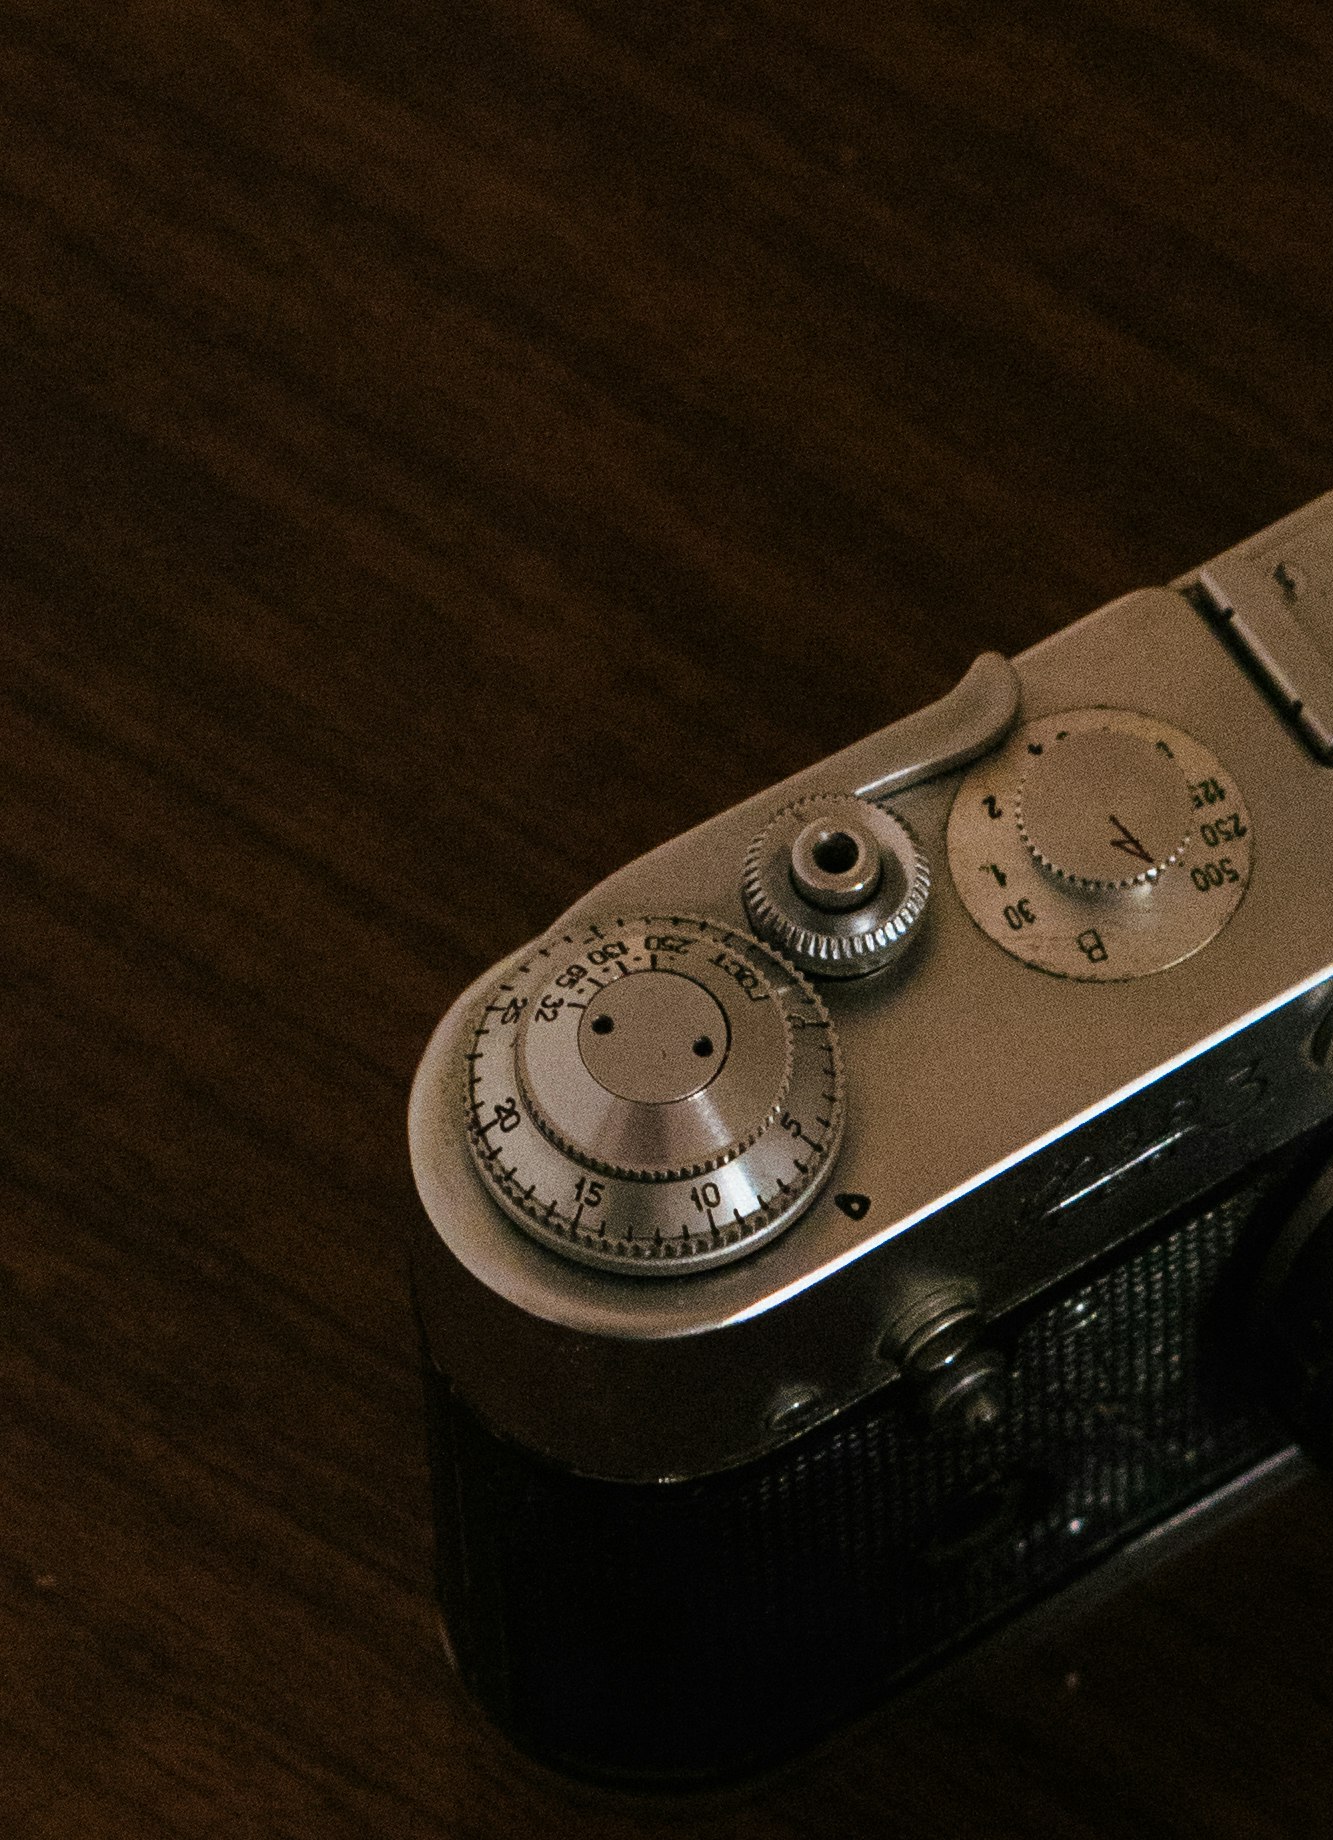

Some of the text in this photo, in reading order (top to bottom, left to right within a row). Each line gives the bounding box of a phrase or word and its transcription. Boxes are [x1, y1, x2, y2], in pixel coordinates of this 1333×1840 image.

[1200, 812, 1247, 847] 250
[1190, 858, 1240, 892] 500
[1003, 898, 1037, 930] 30
[535, 936, 692, 1023] 32 65 130 250
[501, 997, 529, 1026] 25
[494, 1096, 521, 1132] 20
[781, 1112, 802, 1138] 5
[574, 1176, 605, 1208] 15
[691, 1182, 721, 1210] 10
